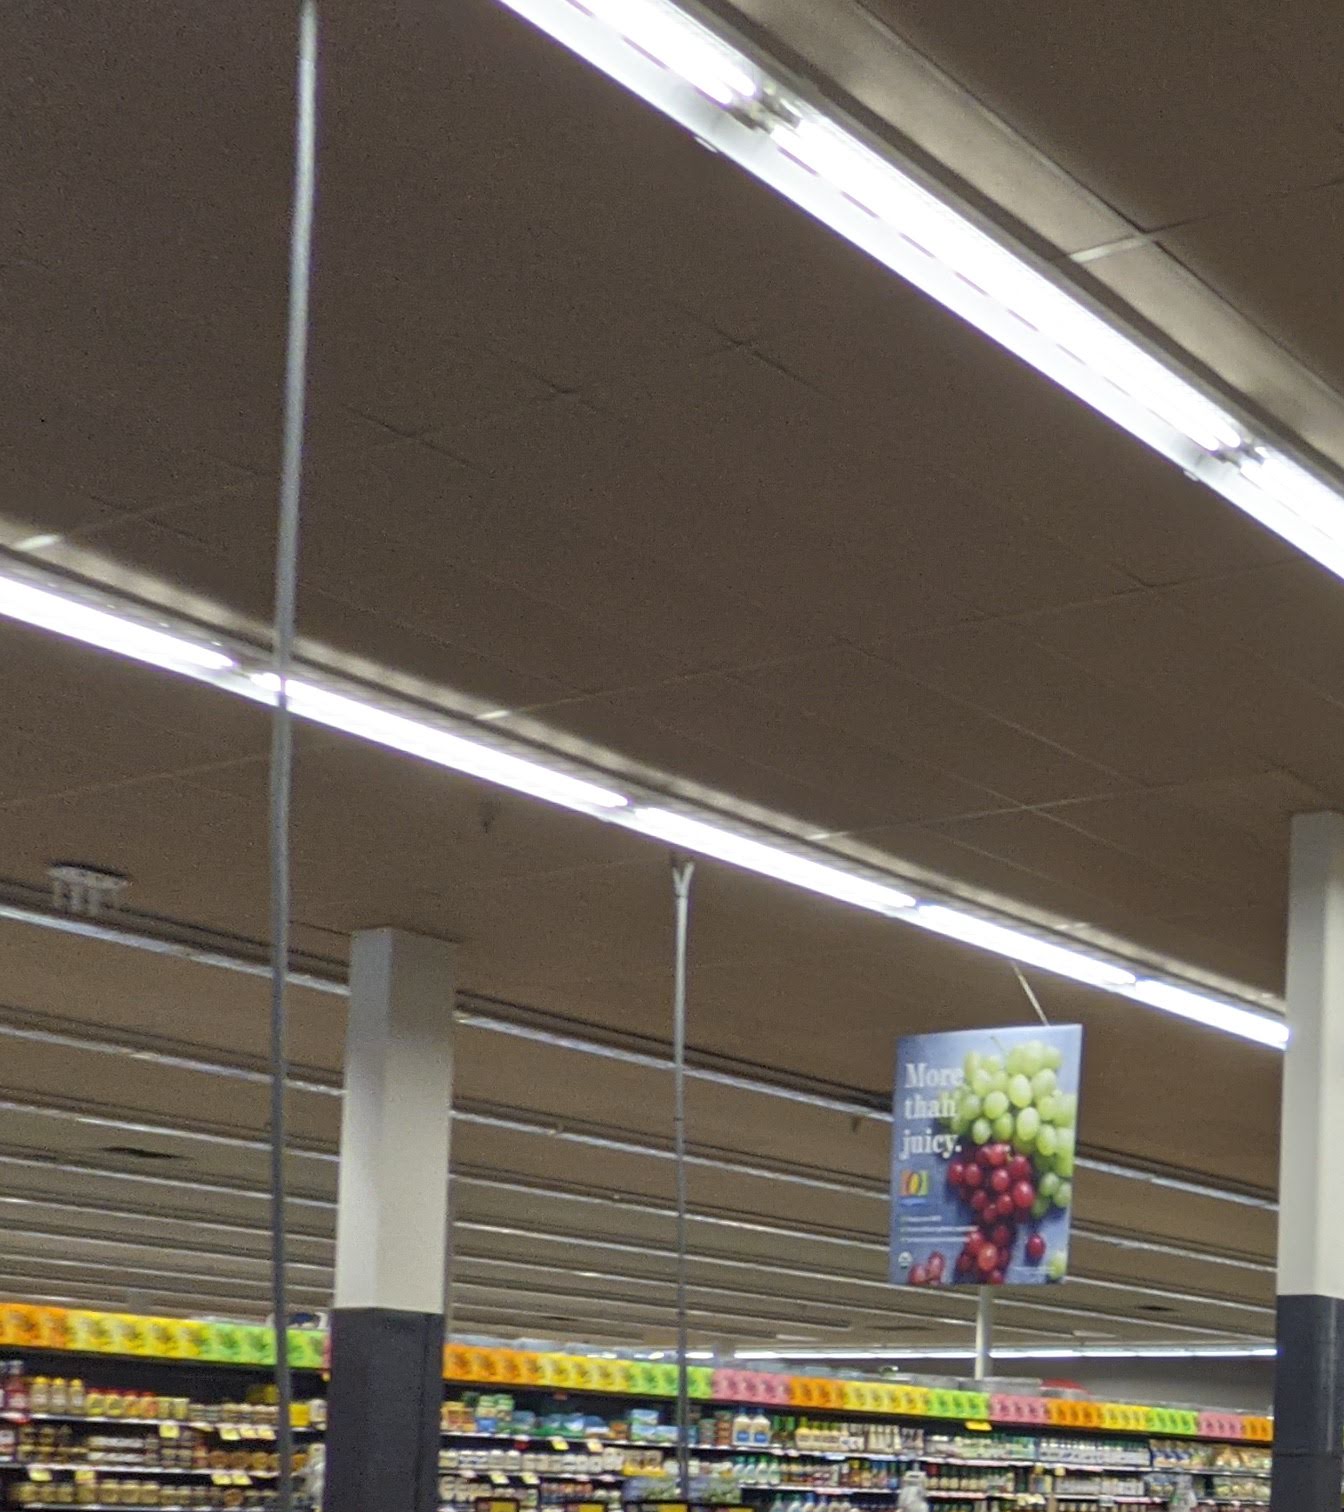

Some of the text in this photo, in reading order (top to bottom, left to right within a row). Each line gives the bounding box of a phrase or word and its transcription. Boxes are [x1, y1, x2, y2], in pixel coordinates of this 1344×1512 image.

[905, 1063, 964, 1089] More
[905, 1093, 959, 1119] than
[901, 1128, 962, 1159] juicy.
